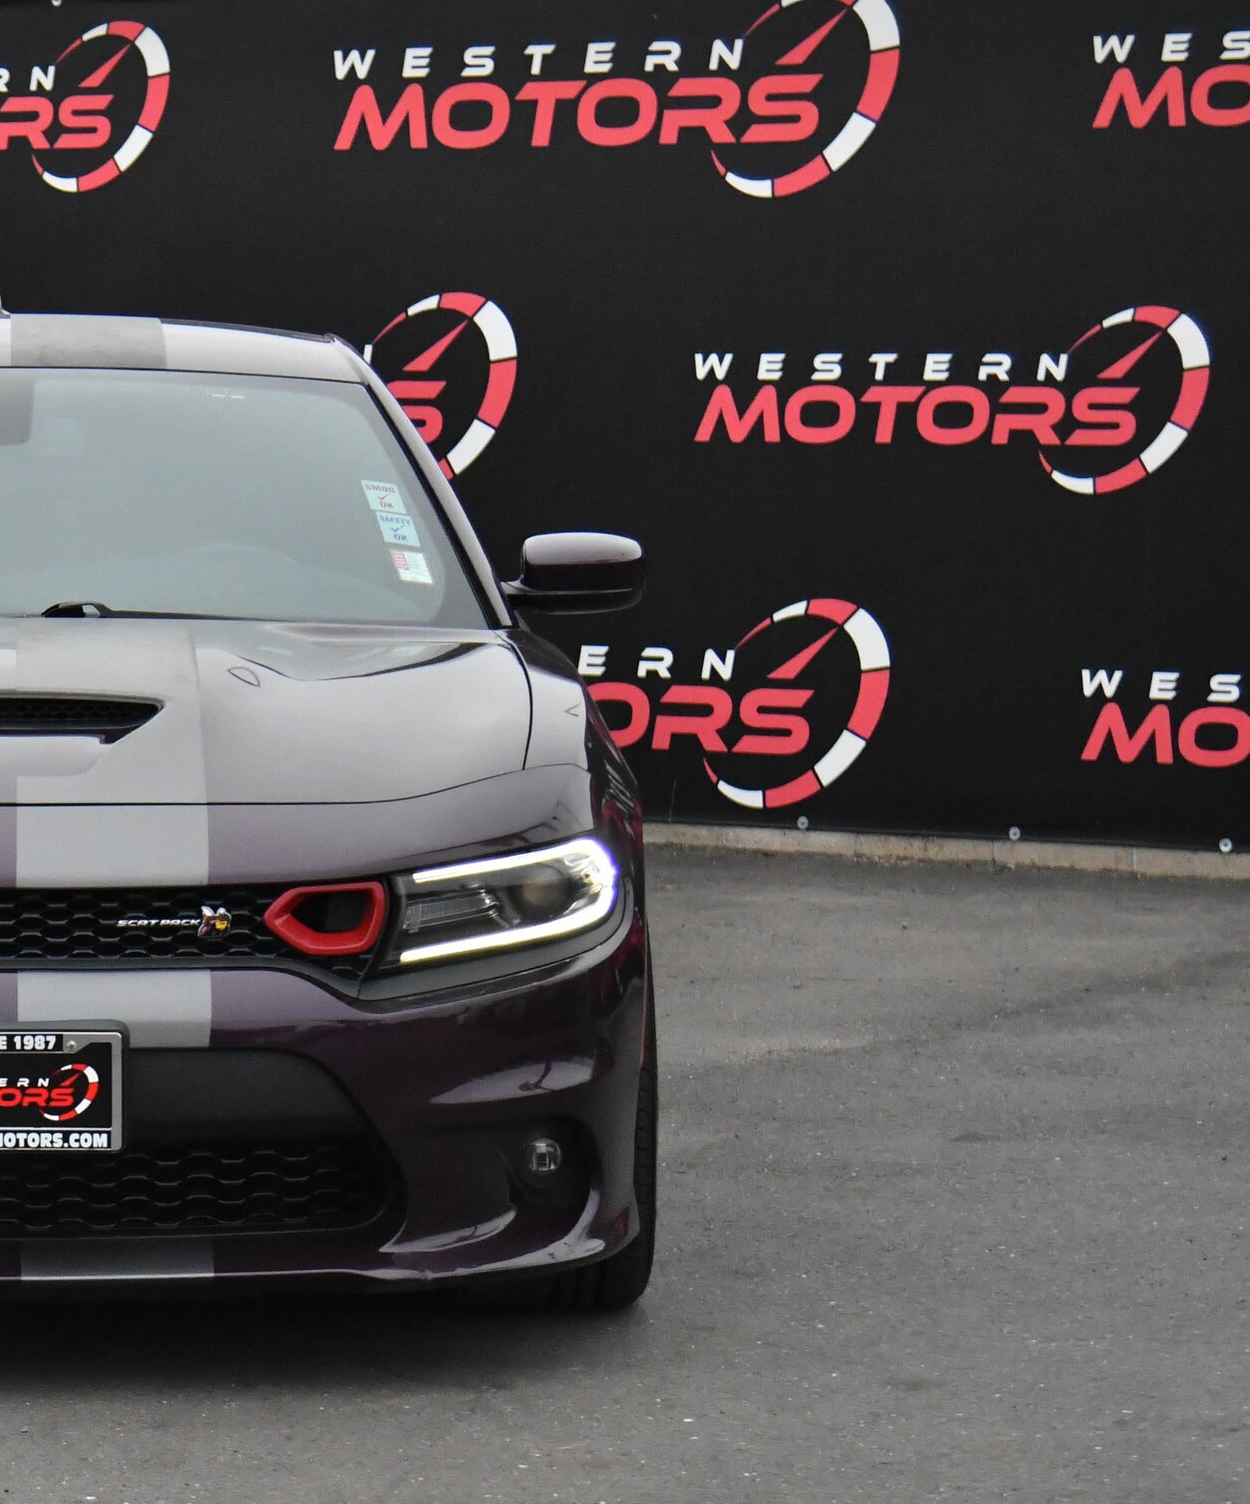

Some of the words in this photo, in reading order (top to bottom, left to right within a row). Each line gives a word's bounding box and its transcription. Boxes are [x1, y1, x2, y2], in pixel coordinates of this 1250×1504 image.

[333, 39, 744, 80] WESTERN
[334, 74, 823, 151] MOTORS
[694, 353, 1069, 381] WESTERN
[695, 384, 1140, 446] MOTORS
[364, 483, 395, 494] SMOG
[380, 501, 394, 509] OK
[379, 514, 410, 526] SAFETY
[394, 533, 409, 542] OK
[13, 1035, 56, 1050] 1987
